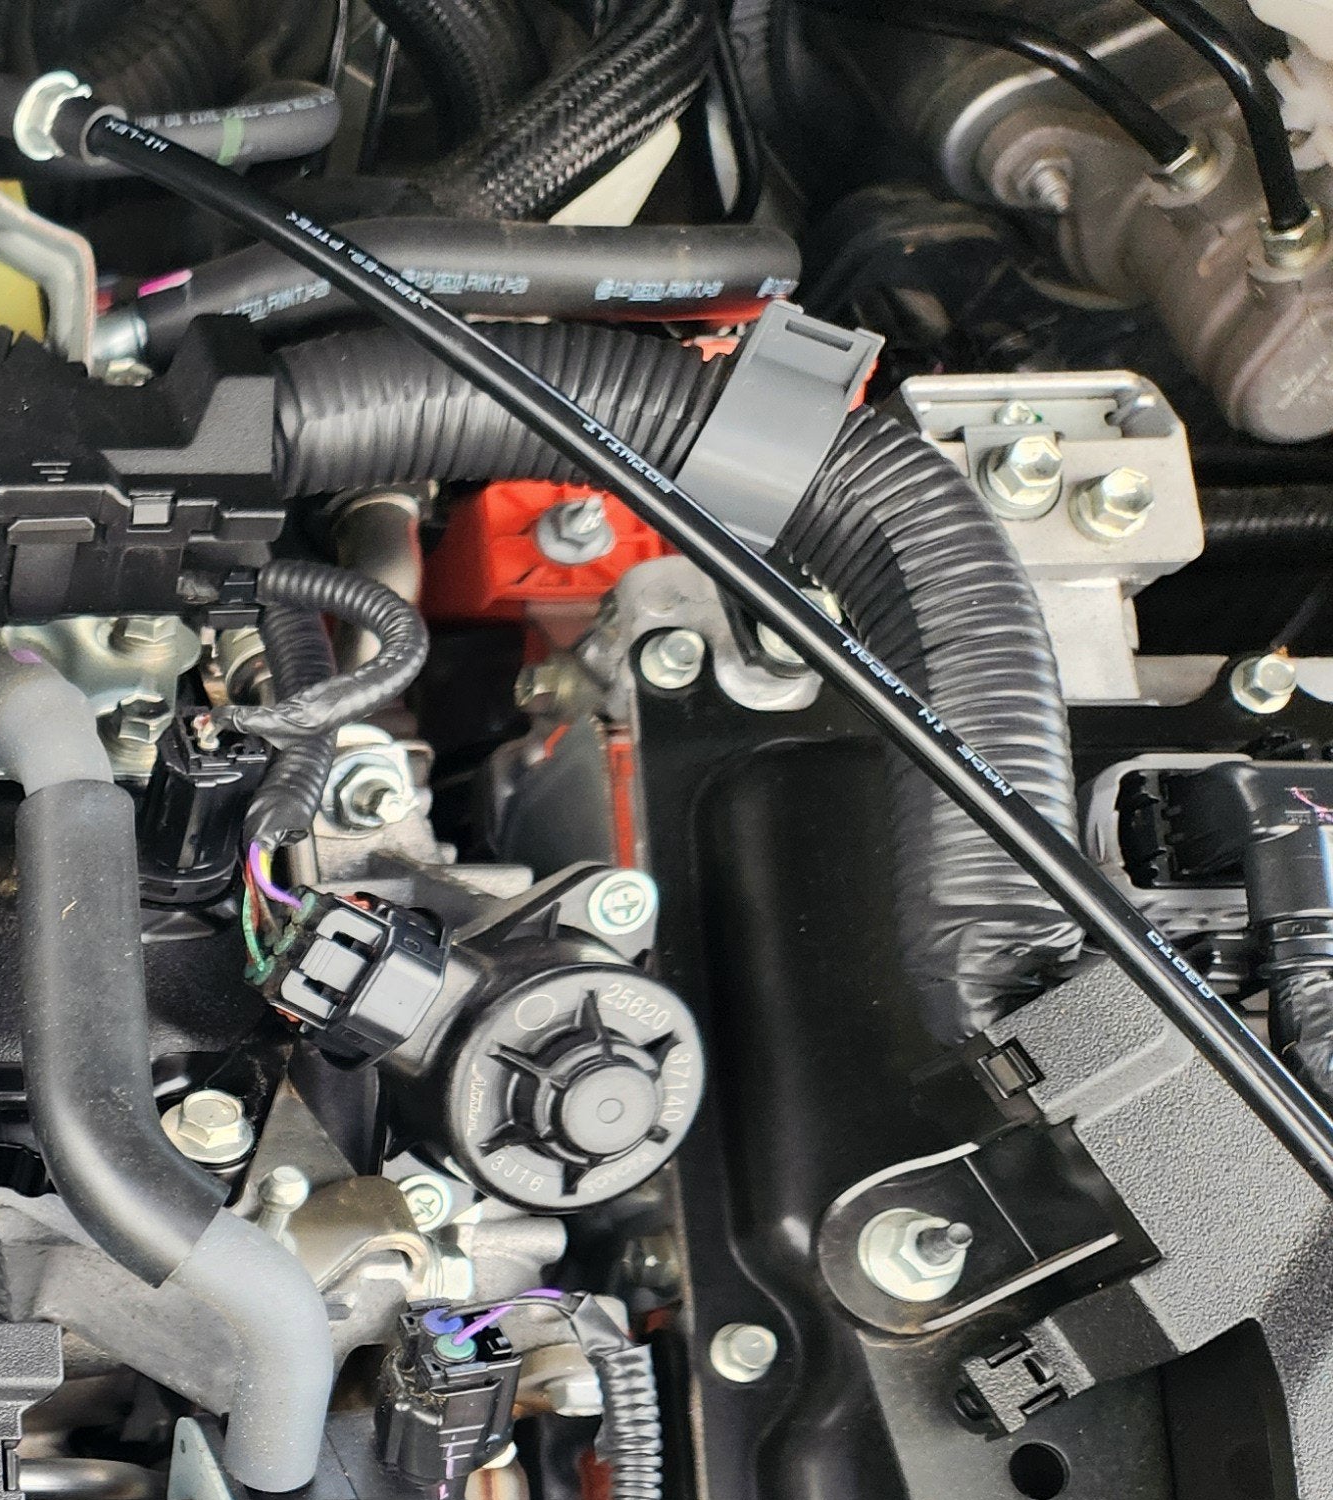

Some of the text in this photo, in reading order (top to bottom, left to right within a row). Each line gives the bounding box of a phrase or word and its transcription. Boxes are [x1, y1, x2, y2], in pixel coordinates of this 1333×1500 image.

[842, 638, 1014, 796] MADE IN JAPAN
[601, 983, 672, 1031] 25820
[661, 1051, 693, 1123] 37140
[489, 1156, 545, 1192] 3J16
